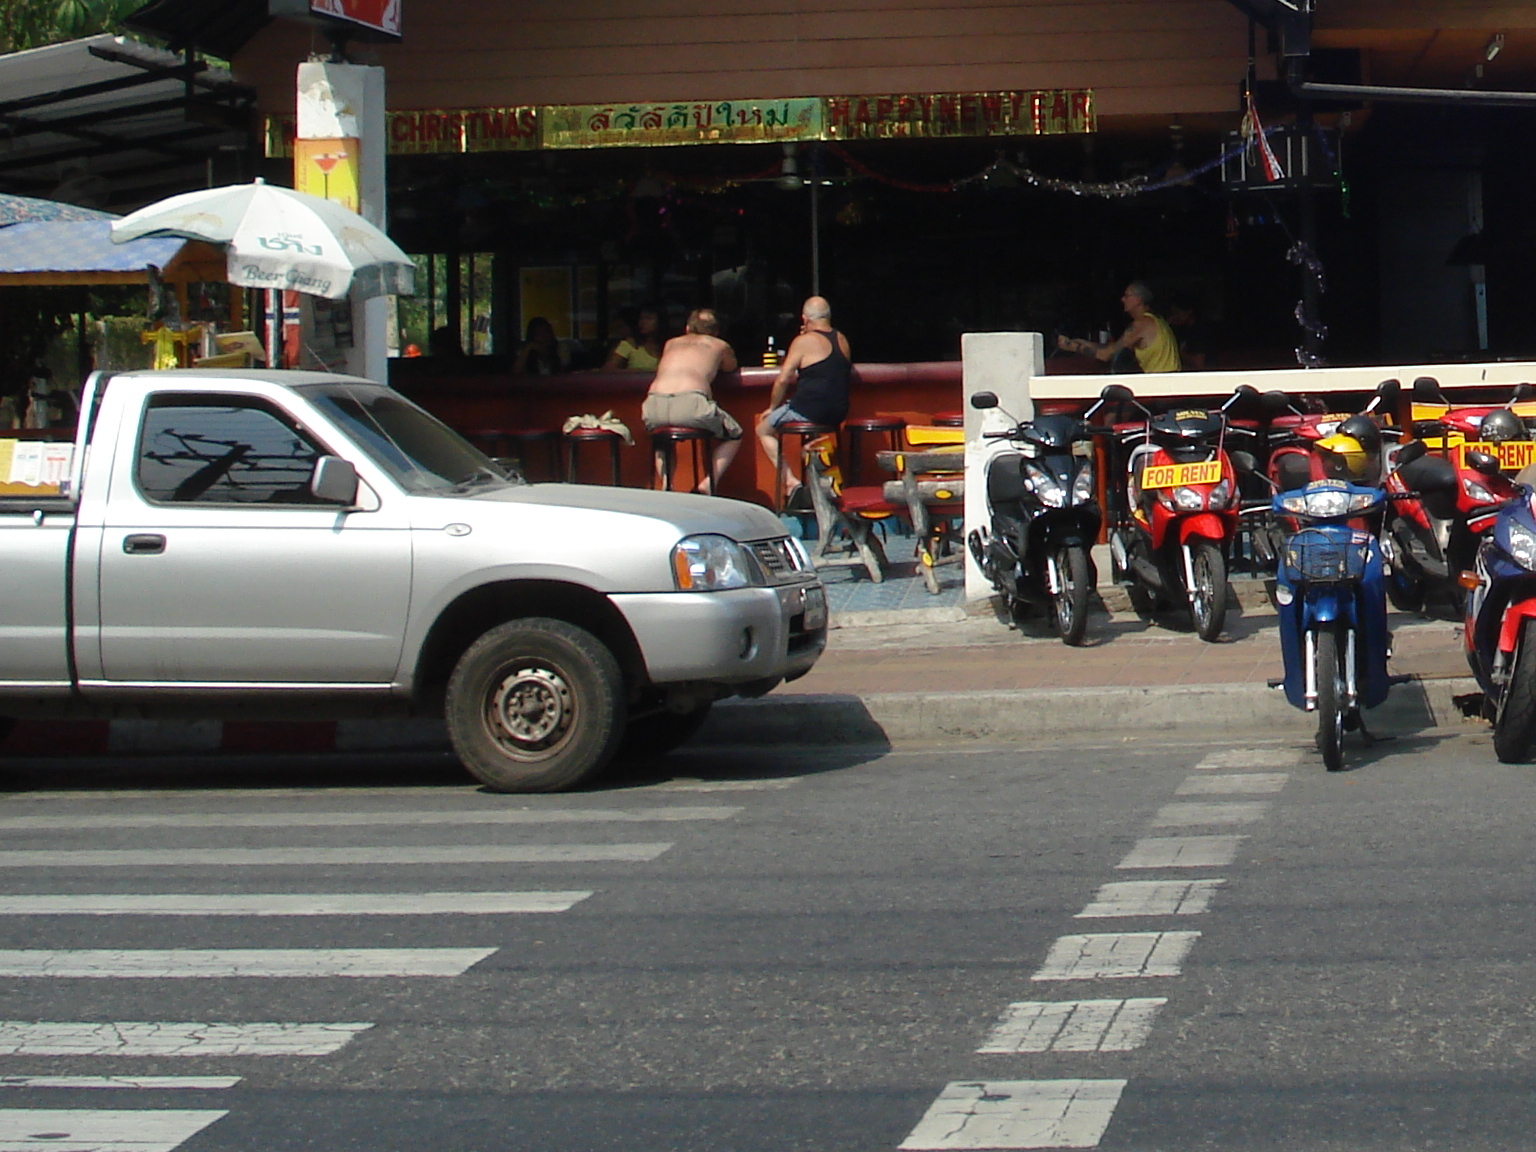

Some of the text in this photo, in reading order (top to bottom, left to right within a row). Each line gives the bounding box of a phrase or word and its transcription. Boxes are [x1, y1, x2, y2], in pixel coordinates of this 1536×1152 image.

[587, 101, 789, 132] สวัสดีปีใหม่
[830, 91, 1091, 126] HAPPY NEW YEAR
[391, 110, 538, 143] CHRISTMAS
[242, 264, 284, 282] Beer
[1497, 445, 1534, 466] RENT
[1146, 463, 1218, 486] FOR RENT
